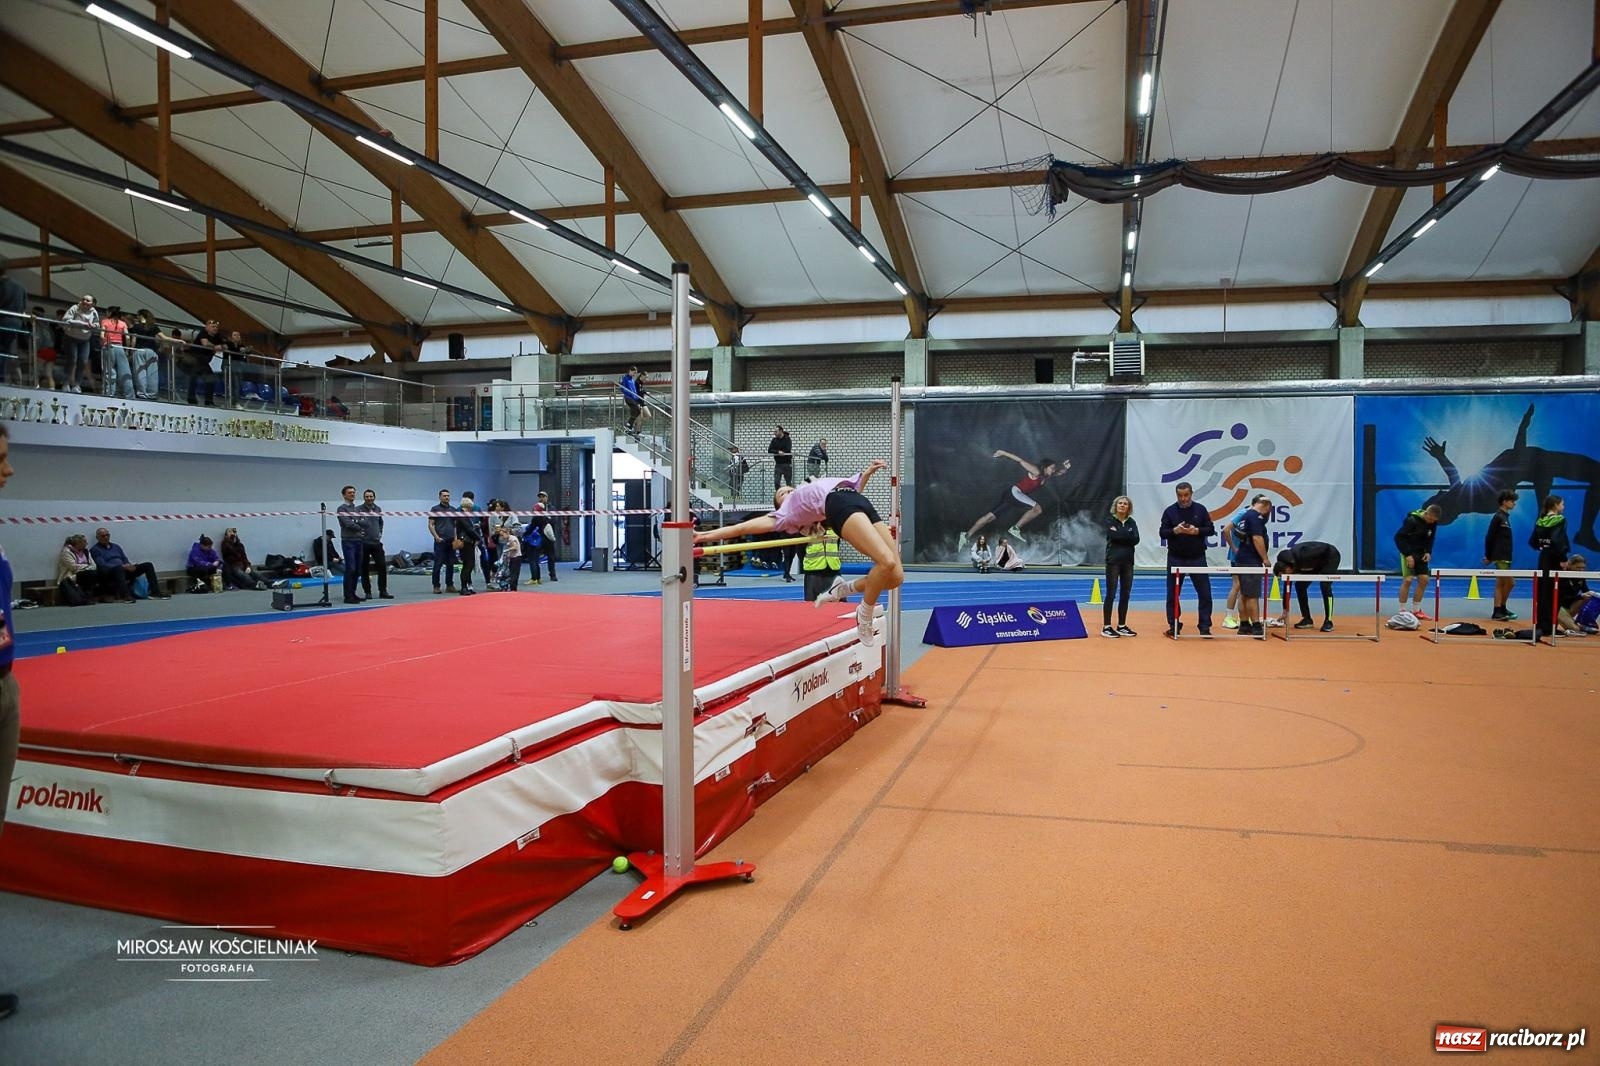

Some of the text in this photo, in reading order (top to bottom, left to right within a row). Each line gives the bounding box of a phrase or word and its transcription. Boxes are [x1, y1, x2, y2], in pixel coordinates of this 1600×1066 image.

[976, 611, 1018, 626] Śląskie.
[995, 628, 1040, 638] smsraciborz.pl
[802, 667, 828, 701] polanik
[16, 782, 103, 813] polanik
